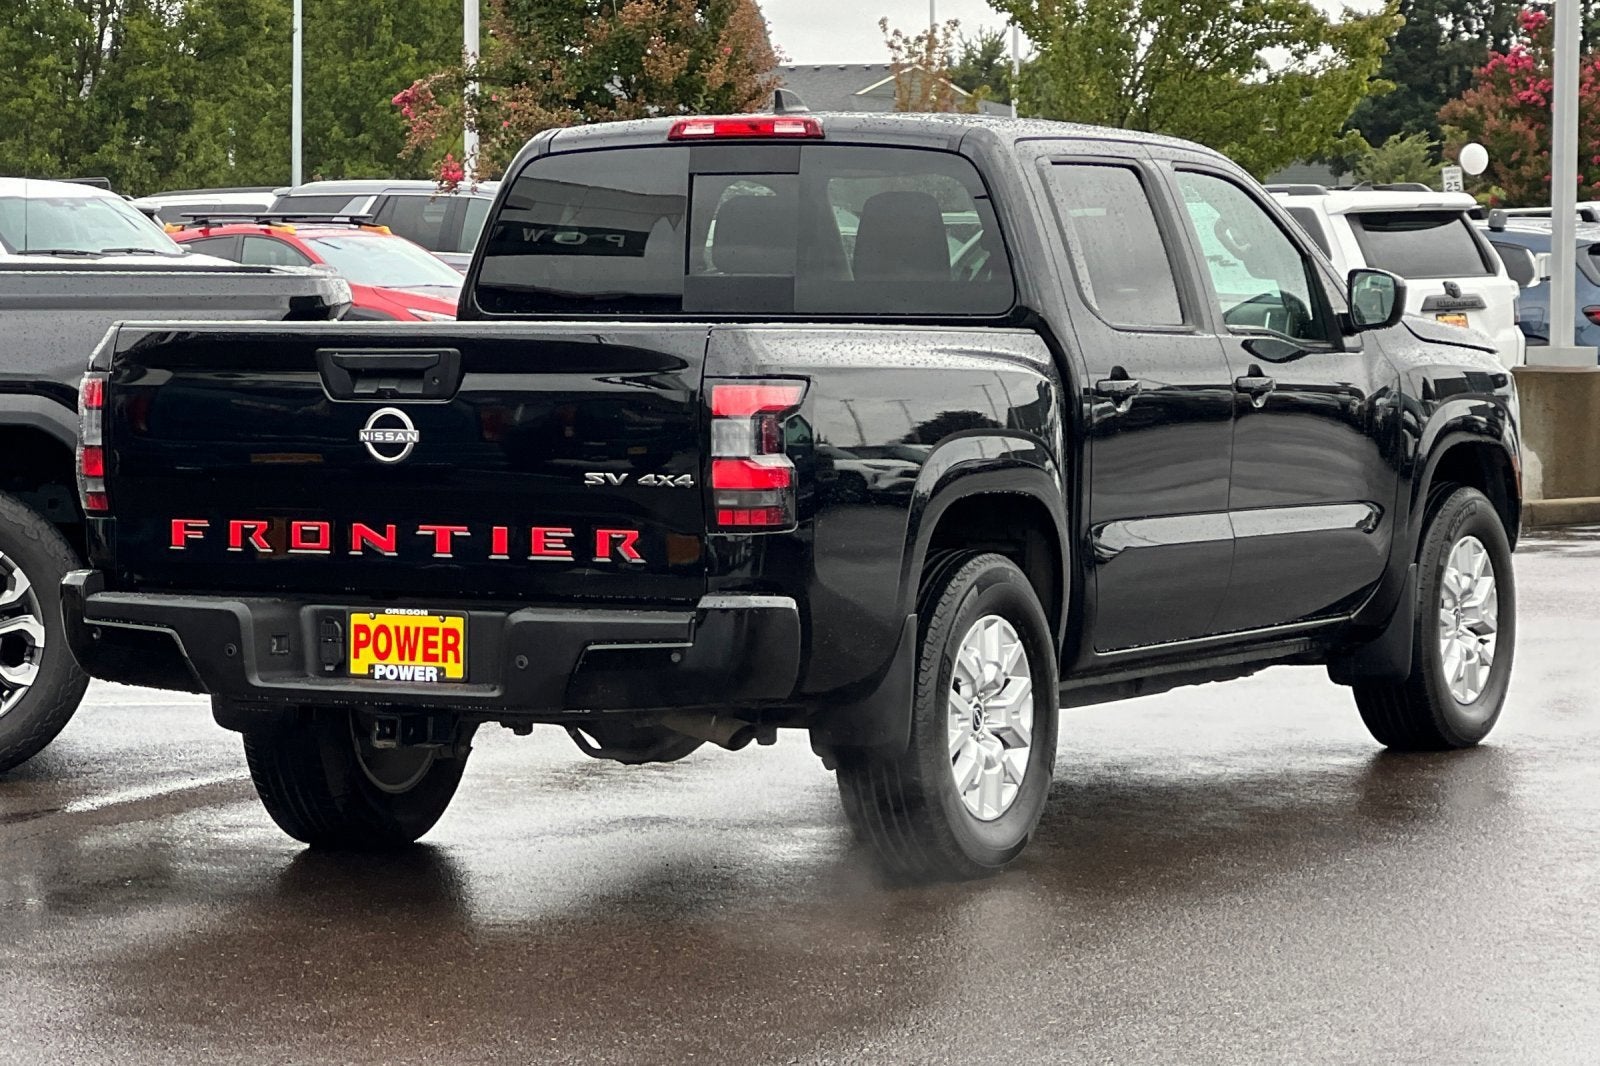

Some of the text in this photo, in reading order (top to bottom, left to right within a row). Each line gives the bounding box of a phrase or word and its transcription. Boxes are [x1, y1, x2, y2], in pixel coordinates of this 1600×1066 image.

[1446, 181, 1461, 192] 25
[360, 431, 418, 442] NISSAN
[584, 472, 629, 486] SV
[169, 518, 647, 564] FRONTIER
[384, 608, 429, 616] OREGON
[353, 623, 461, 664] POWER
[374, 664, 438, 682] POWER
